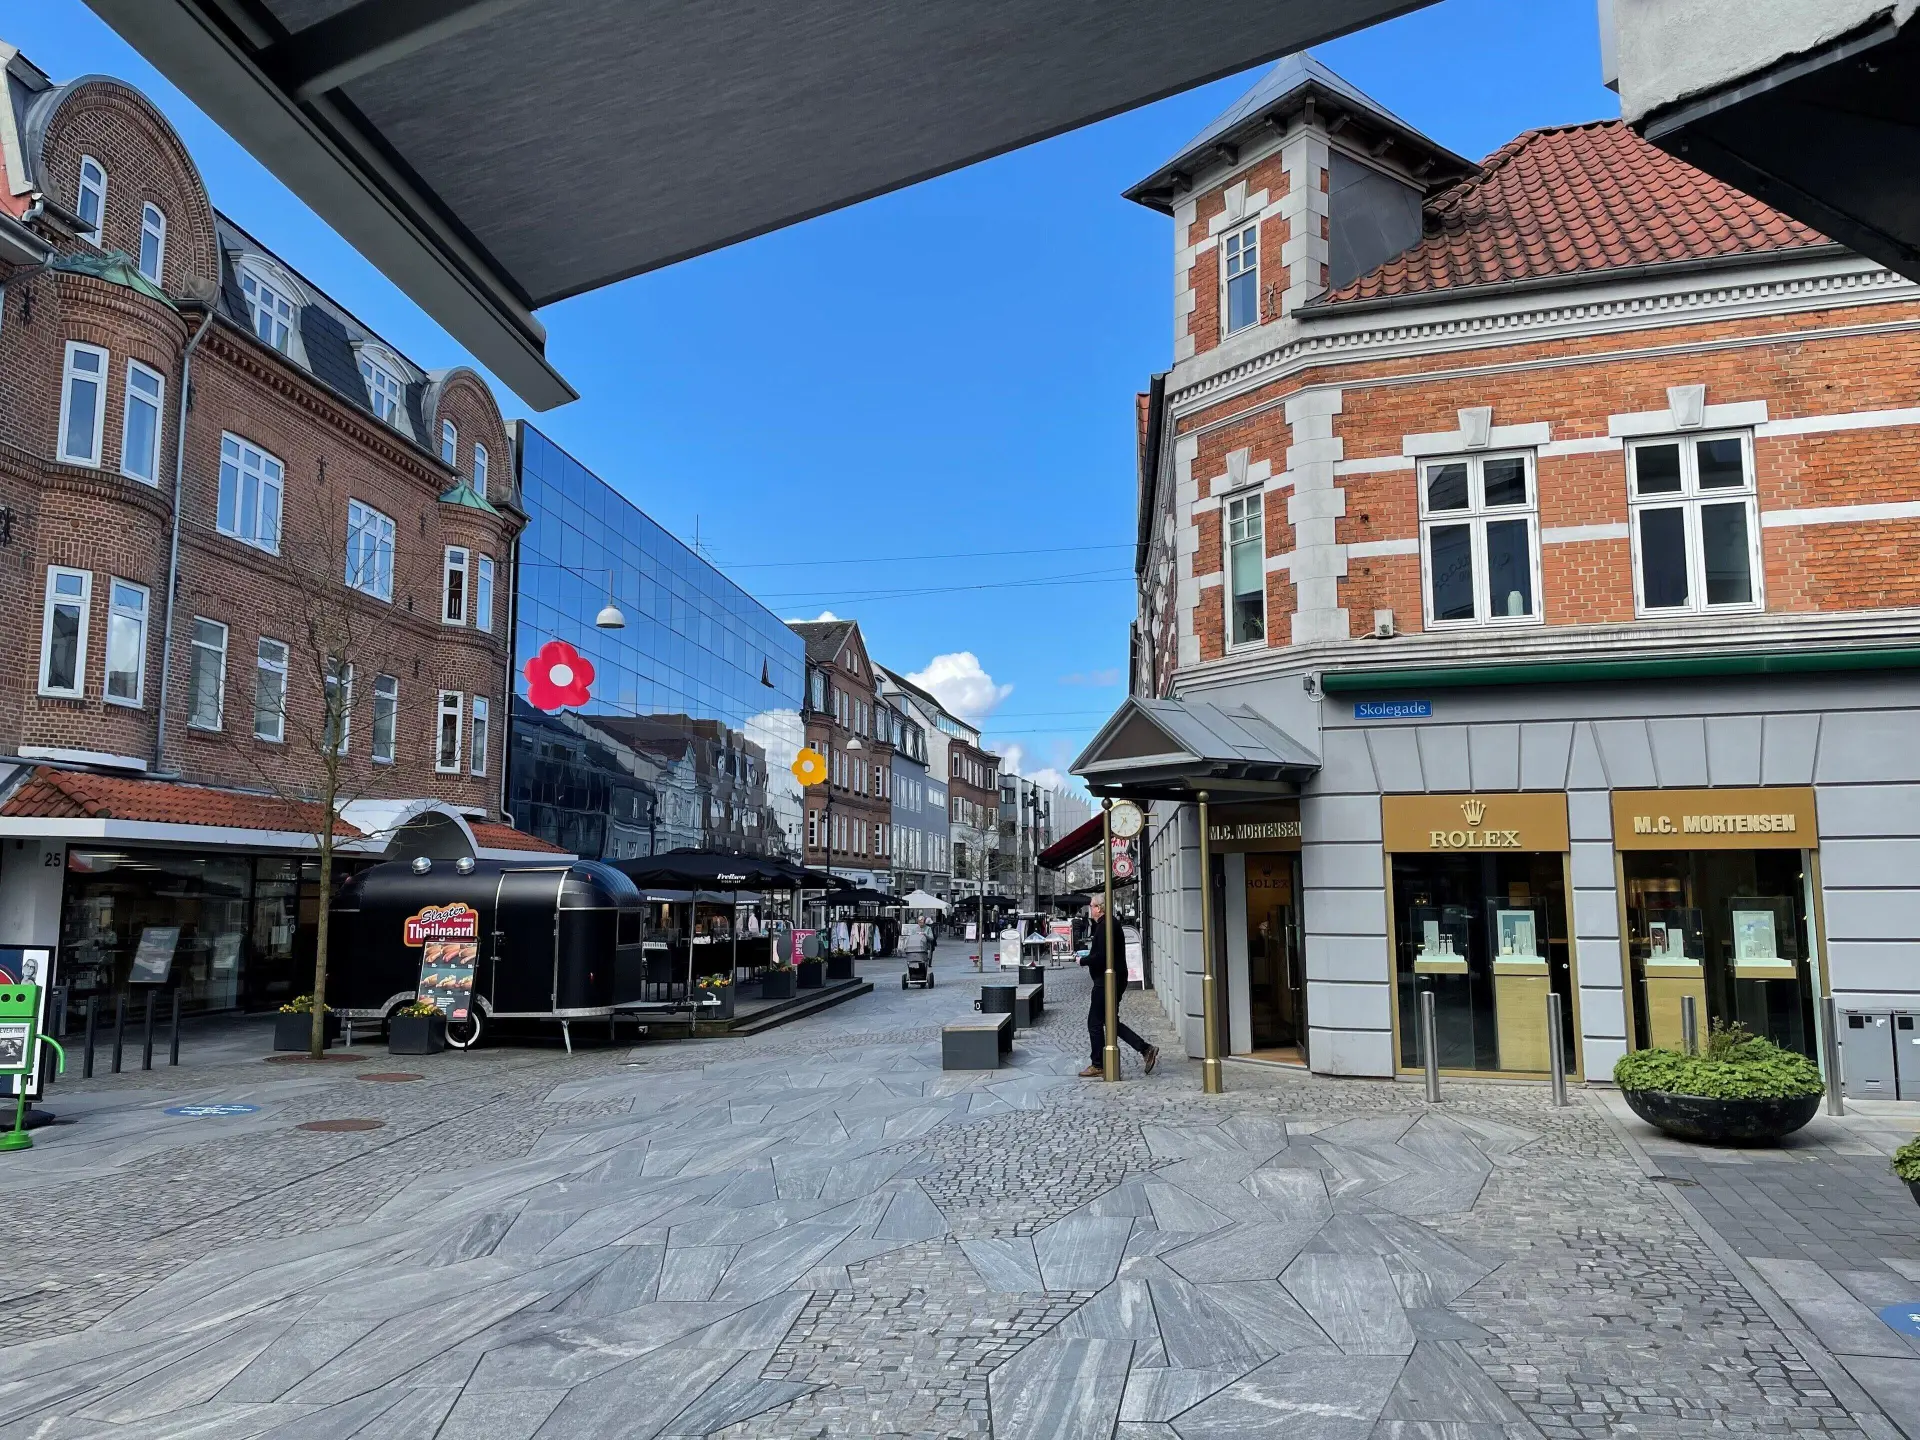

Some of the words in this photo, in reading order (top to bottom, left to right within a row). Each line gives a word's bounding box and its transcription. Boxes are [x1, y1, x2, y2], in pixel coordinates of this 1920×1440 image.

[1360, 702, 1426, 717] Skolegade
[1209, 825, 1235, 841] M.C.
[1236, 821, 1302, 839] MORTENSEN
[1633, 816, 1678, 834] M.C.
[1683, 814, 1796, 833] MORTENSEN
[1429, 830, 1522, 849] ROLEX
[44, 852, 61, 867] 25
[421, 907, 466, 923] Slagter
[408, 924, 474, 941] Theilgaard
